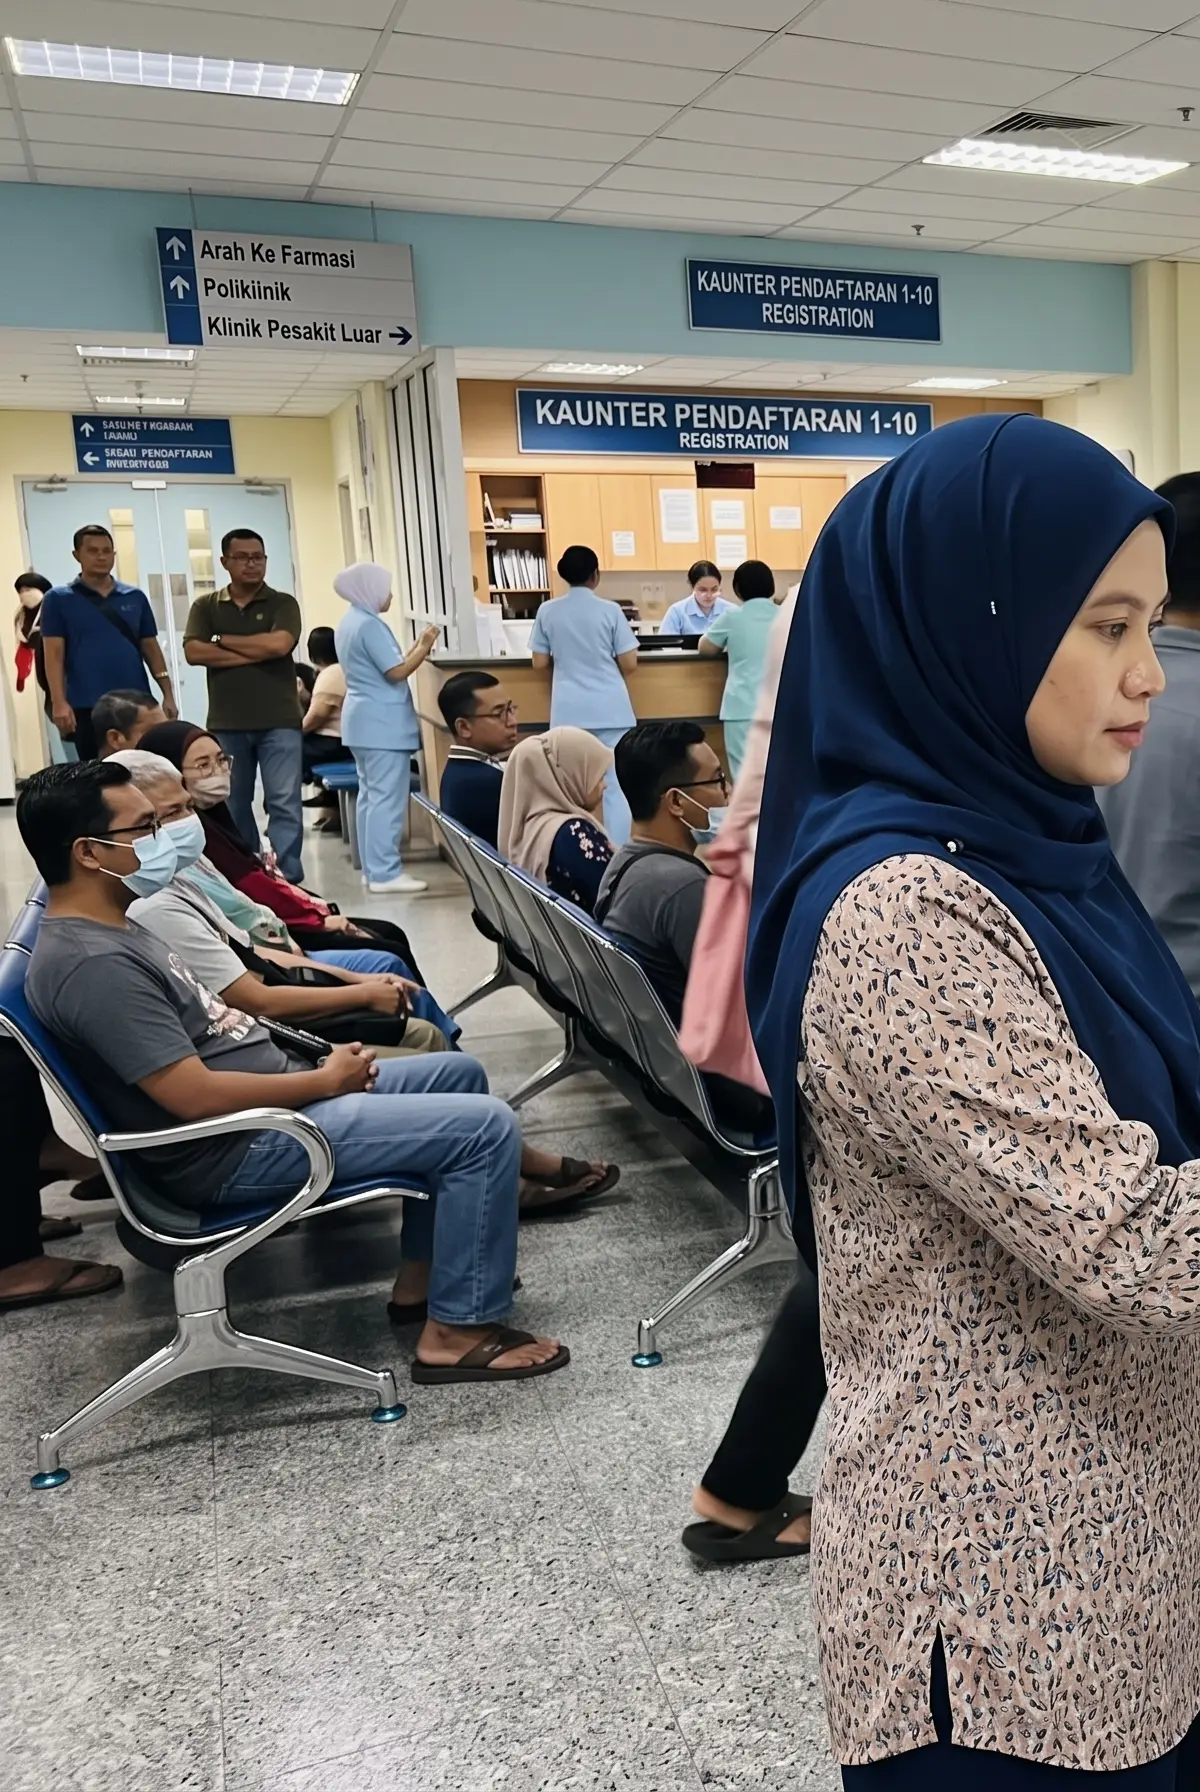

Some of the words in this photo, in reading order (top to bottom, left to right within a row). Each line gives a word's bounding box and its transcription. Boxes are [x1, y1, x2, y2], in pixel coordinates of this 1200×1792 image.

[200, 240, 245, 262] Arah
[251, 242, 276, 264] Ke
[281, 244, 356, 269] Farmasi
[203, 277, 292, 302] Polikiinik
[697, 270, 777, 296] KAUNTER
[781, 275, 897, 303] PENDAFTARAN
[901, 284, 933, 305] 1-10
[207, 316, 263, 339] Klinik
[267, 319, 336, 342] Pesakit
[341, 323, 382, 344] Luar
[762, 303, 874, 329] REGISTRATION
[536, 399, 668, 428] KAUNTER
[675, 403, 862, 434] PENDAFTARAN
[869, 410, 918, 436] 1-10
[679, 432, 789, 451] REGISTRATION
